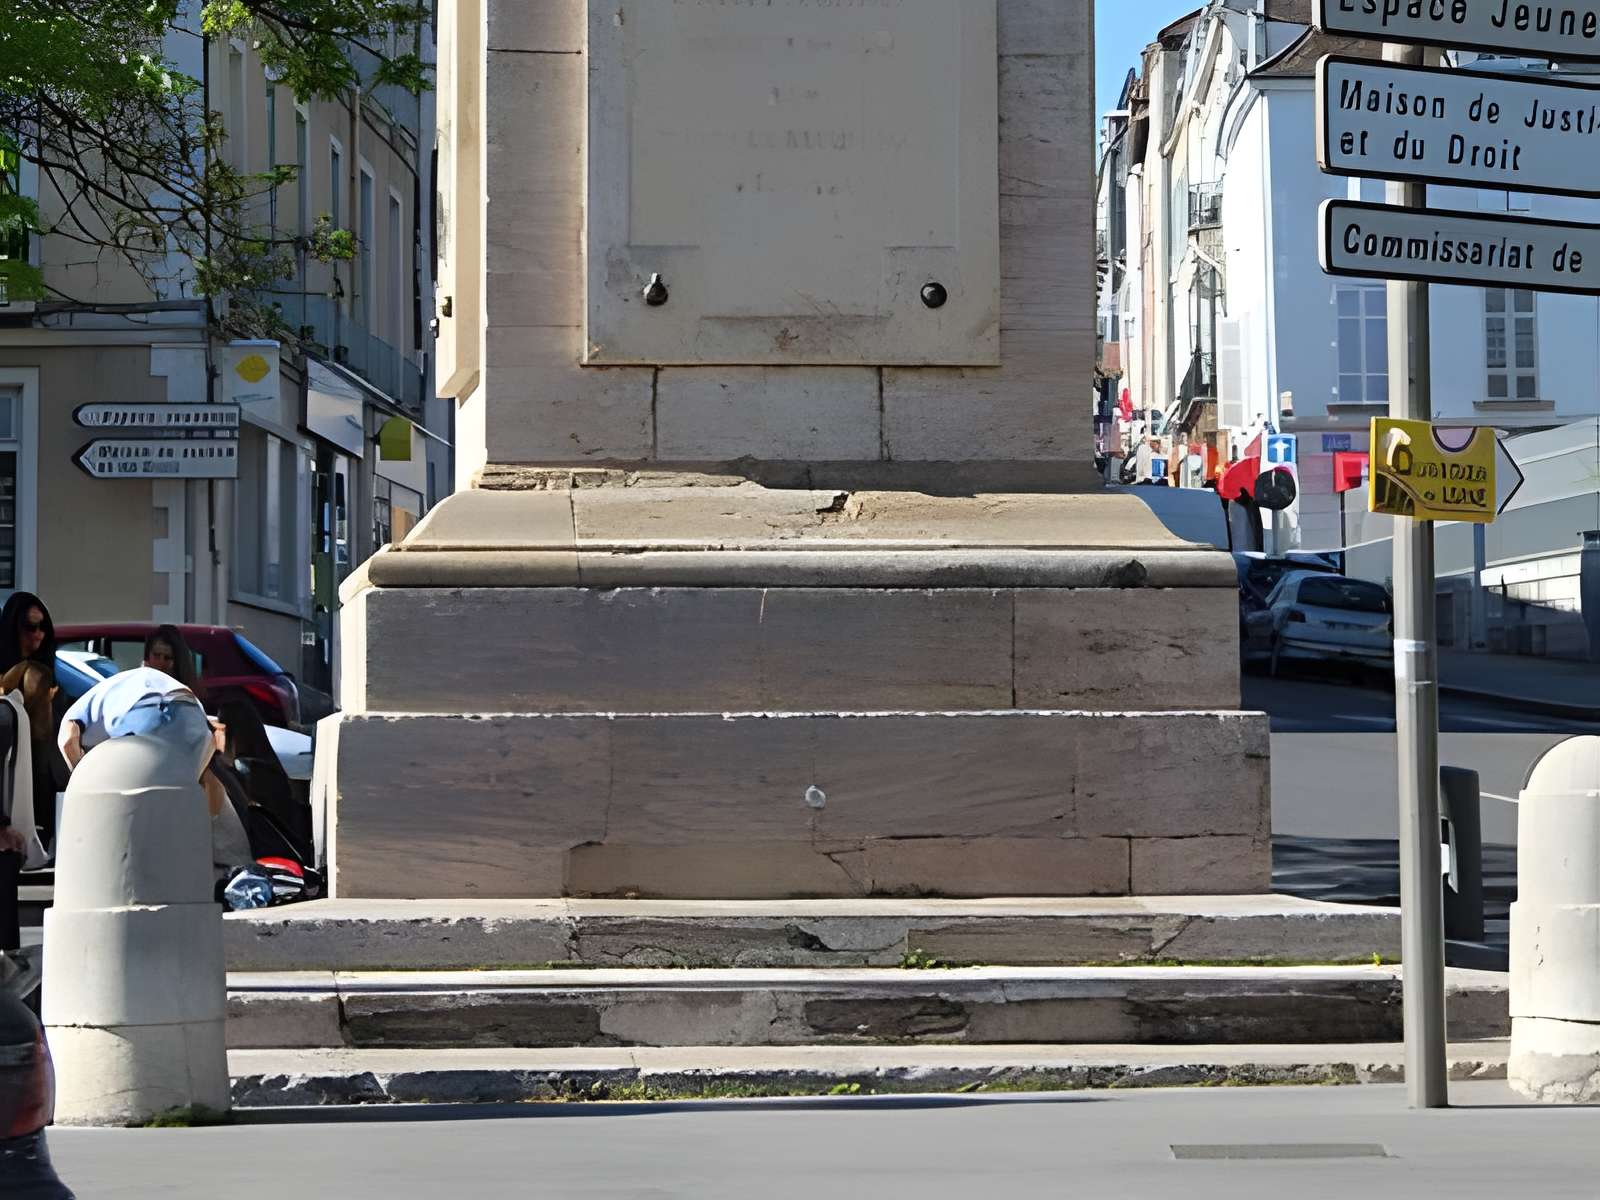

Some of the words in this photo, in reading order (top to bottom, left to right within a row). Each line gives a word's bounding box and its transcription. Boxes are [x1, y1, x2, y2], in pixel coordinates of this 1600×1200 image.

[1340, 79, 1445, 119] Maison
[1468, 92, 1500, 124] de
[1524, 99, 1600, 134] Justi
[1340, 130, 1369, 156] et
[1393, 129, 1425, 161] du
[1447, 133, 1521, 171] Droit
[1343, 223, 1534, 269] Commissariat
[1552, 242, 1583, 274] de
